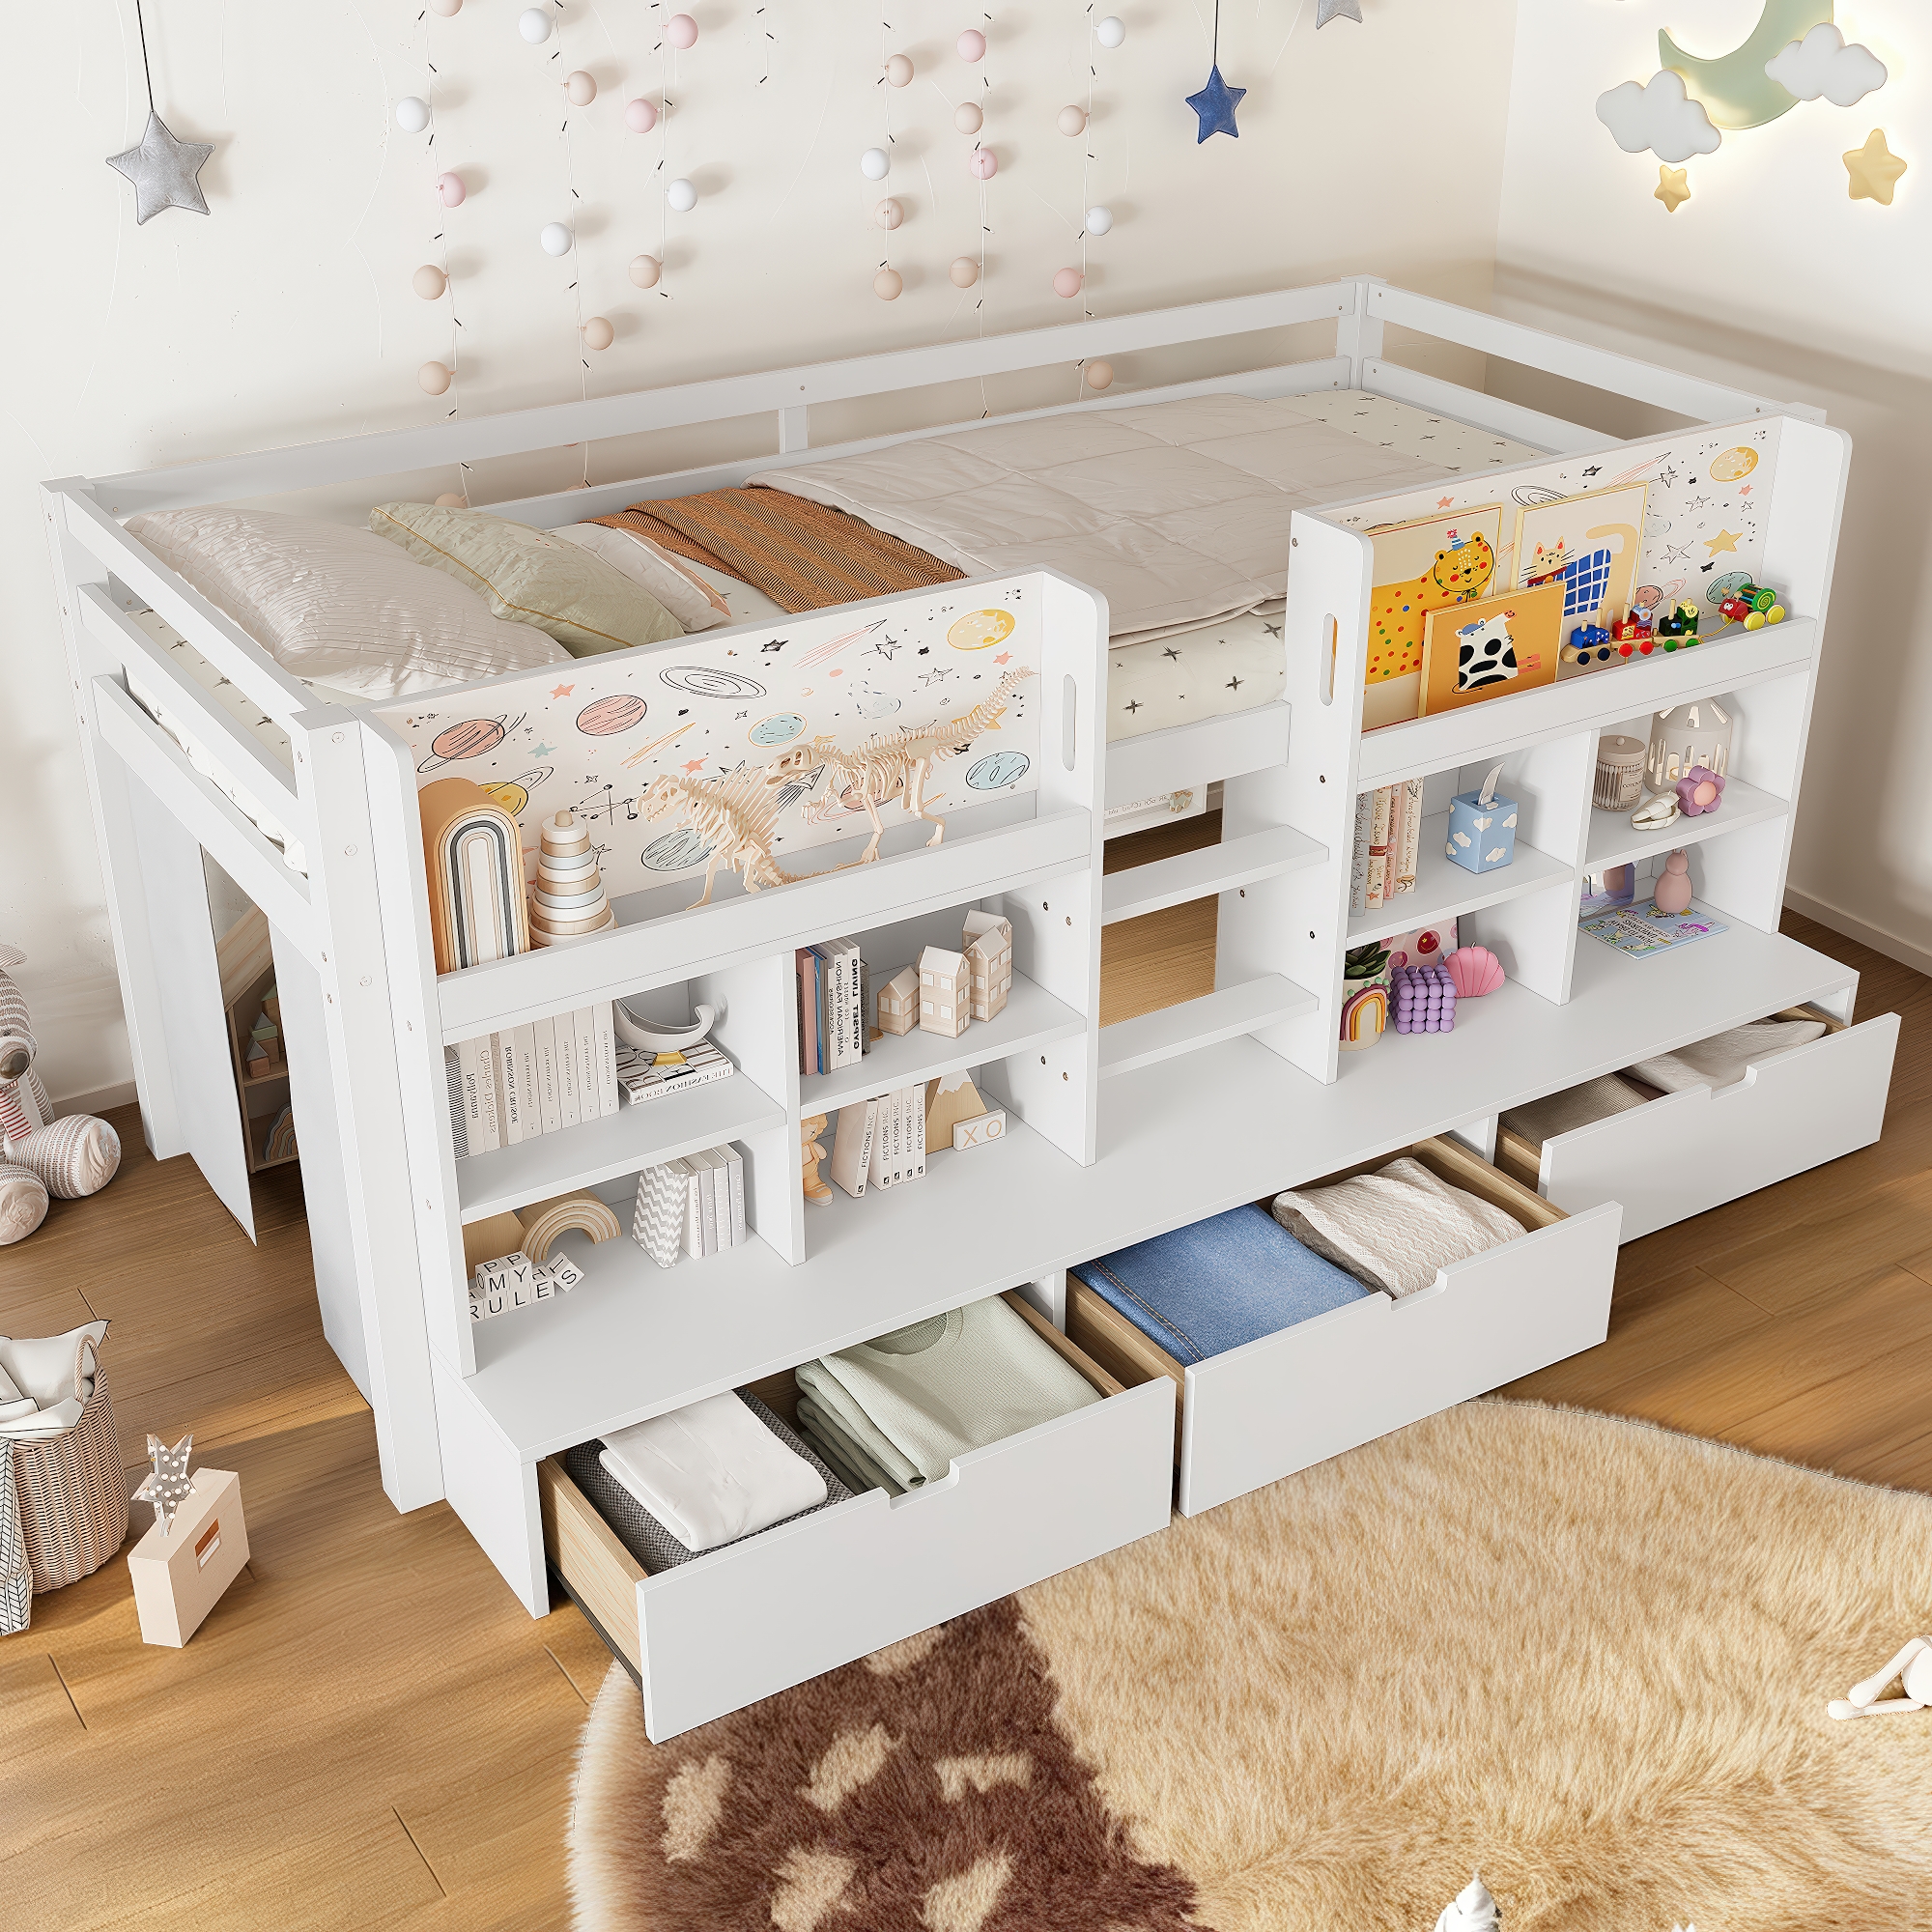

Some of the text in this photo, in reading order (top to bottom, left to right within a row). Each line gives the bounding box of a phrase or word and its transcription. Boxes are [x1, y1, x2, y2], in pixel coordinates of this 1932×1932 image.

[862, 1130, 872, 1168] FICTIONS
[469, 1269, 577, 1320] RULES
[489, 1265, 527, 1293] MY
